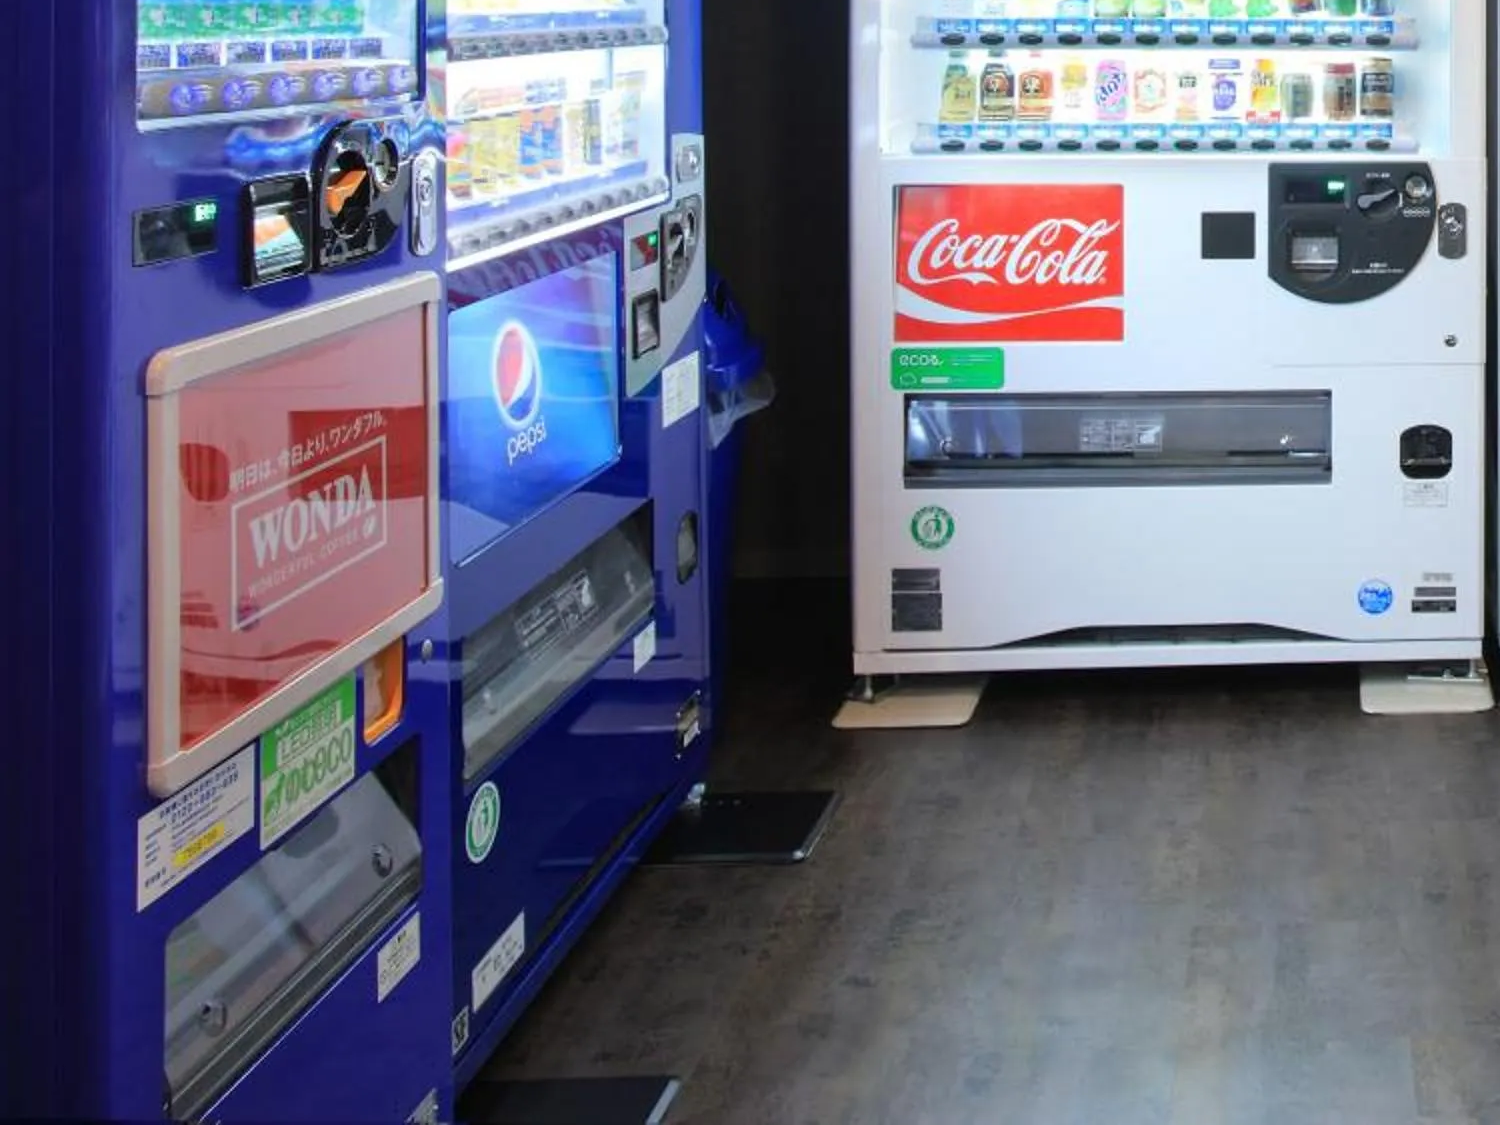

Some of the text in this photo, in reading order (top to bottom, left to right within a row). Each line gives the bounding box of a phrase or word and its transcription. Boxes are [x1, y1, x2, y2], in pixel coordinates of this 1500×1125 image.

[908, 219, 1120, 285] Coca-Cola
[507, 415, 547, 467] pepsi
[250, 464, 376, 569] WONDA
